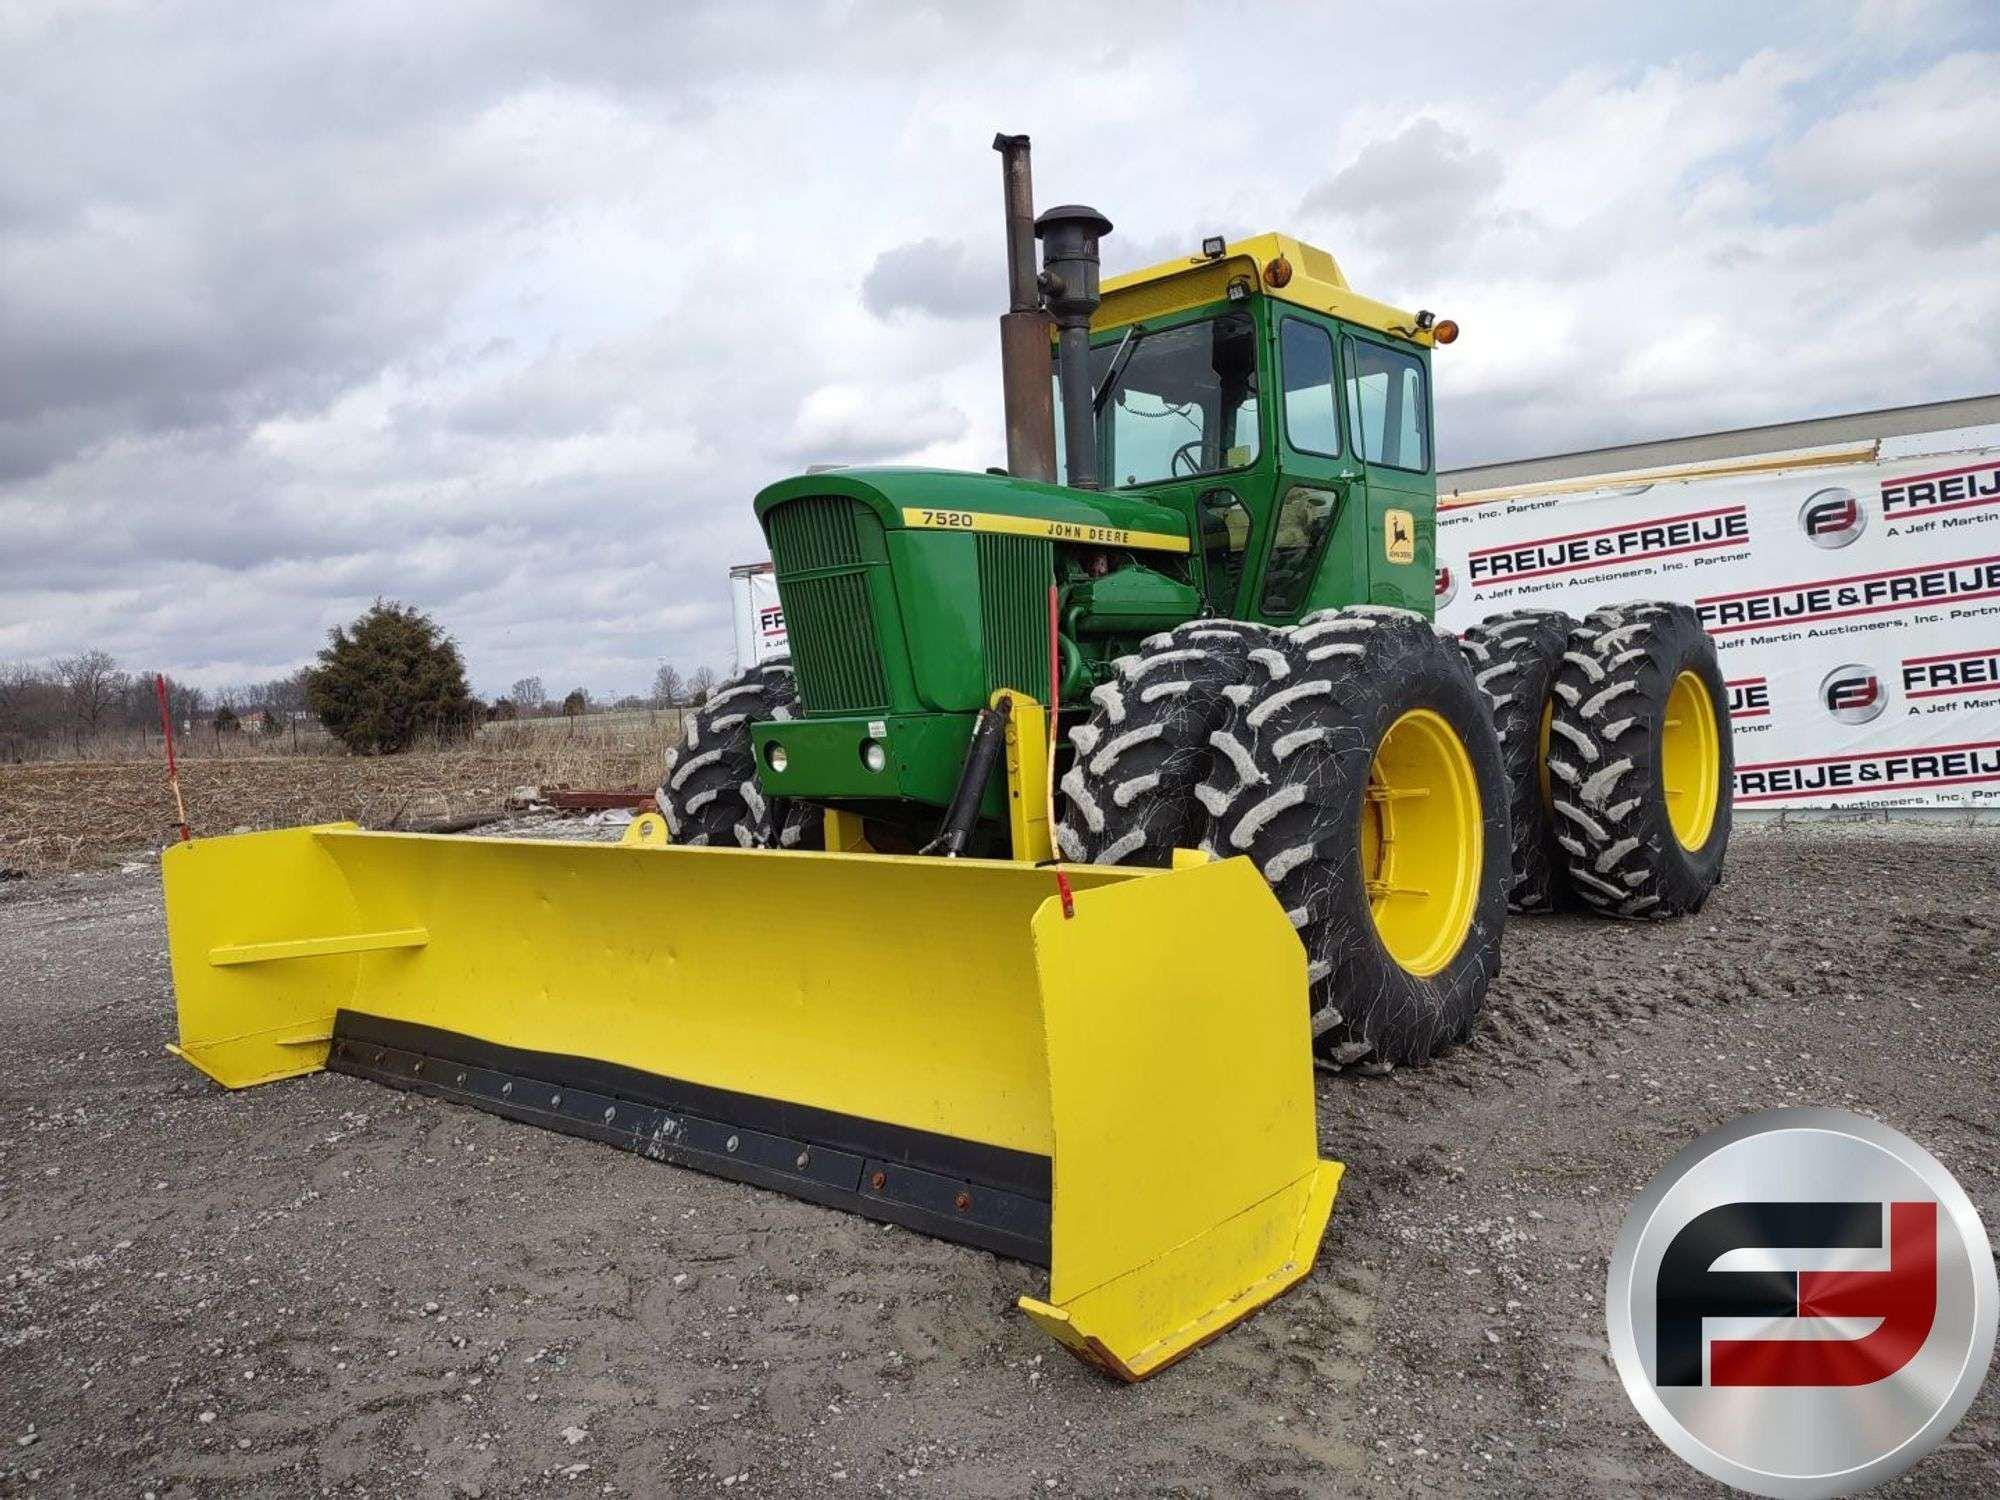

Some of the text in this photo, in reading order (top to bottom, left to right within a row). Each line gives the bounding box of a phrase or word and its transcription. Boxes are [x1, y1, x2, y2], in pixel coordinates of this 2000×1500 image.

[1881, 470, 2000, 512] FREIJ
[922, 511, 973, 527] 7520
[1507, 500, 1559, 514] Partner
[1048, 523, 1129, 543] JOHN DEERE
[1887, 512, 1999, 537] A Jeff Martin
[1474, 593, 1484, 601] A
[1489, 588, 1513, 599] Jeff
[1518, 581, 1563, 594] Martin
[1662, 562, 1689, 571] Inc.
[1694, 551, 1751, 566] Partner
[1718, 638, 1745, 650] Jeff
[1750, 632, 1801, 646] Martin
[1915, 614, 1943, 624] Inc.
[1950, 607, 2000, 619] Partn
[1903, 658, 1999, 690] FREI
[1908, 707, 1920, 715] A
[1927, 701, 1958, 713] Jeff
[1734, 723, 1772, 734] rtner
[1734, 764, 1854, 794] REIJE
[1885, 749, 2000, 781] FREIJ
